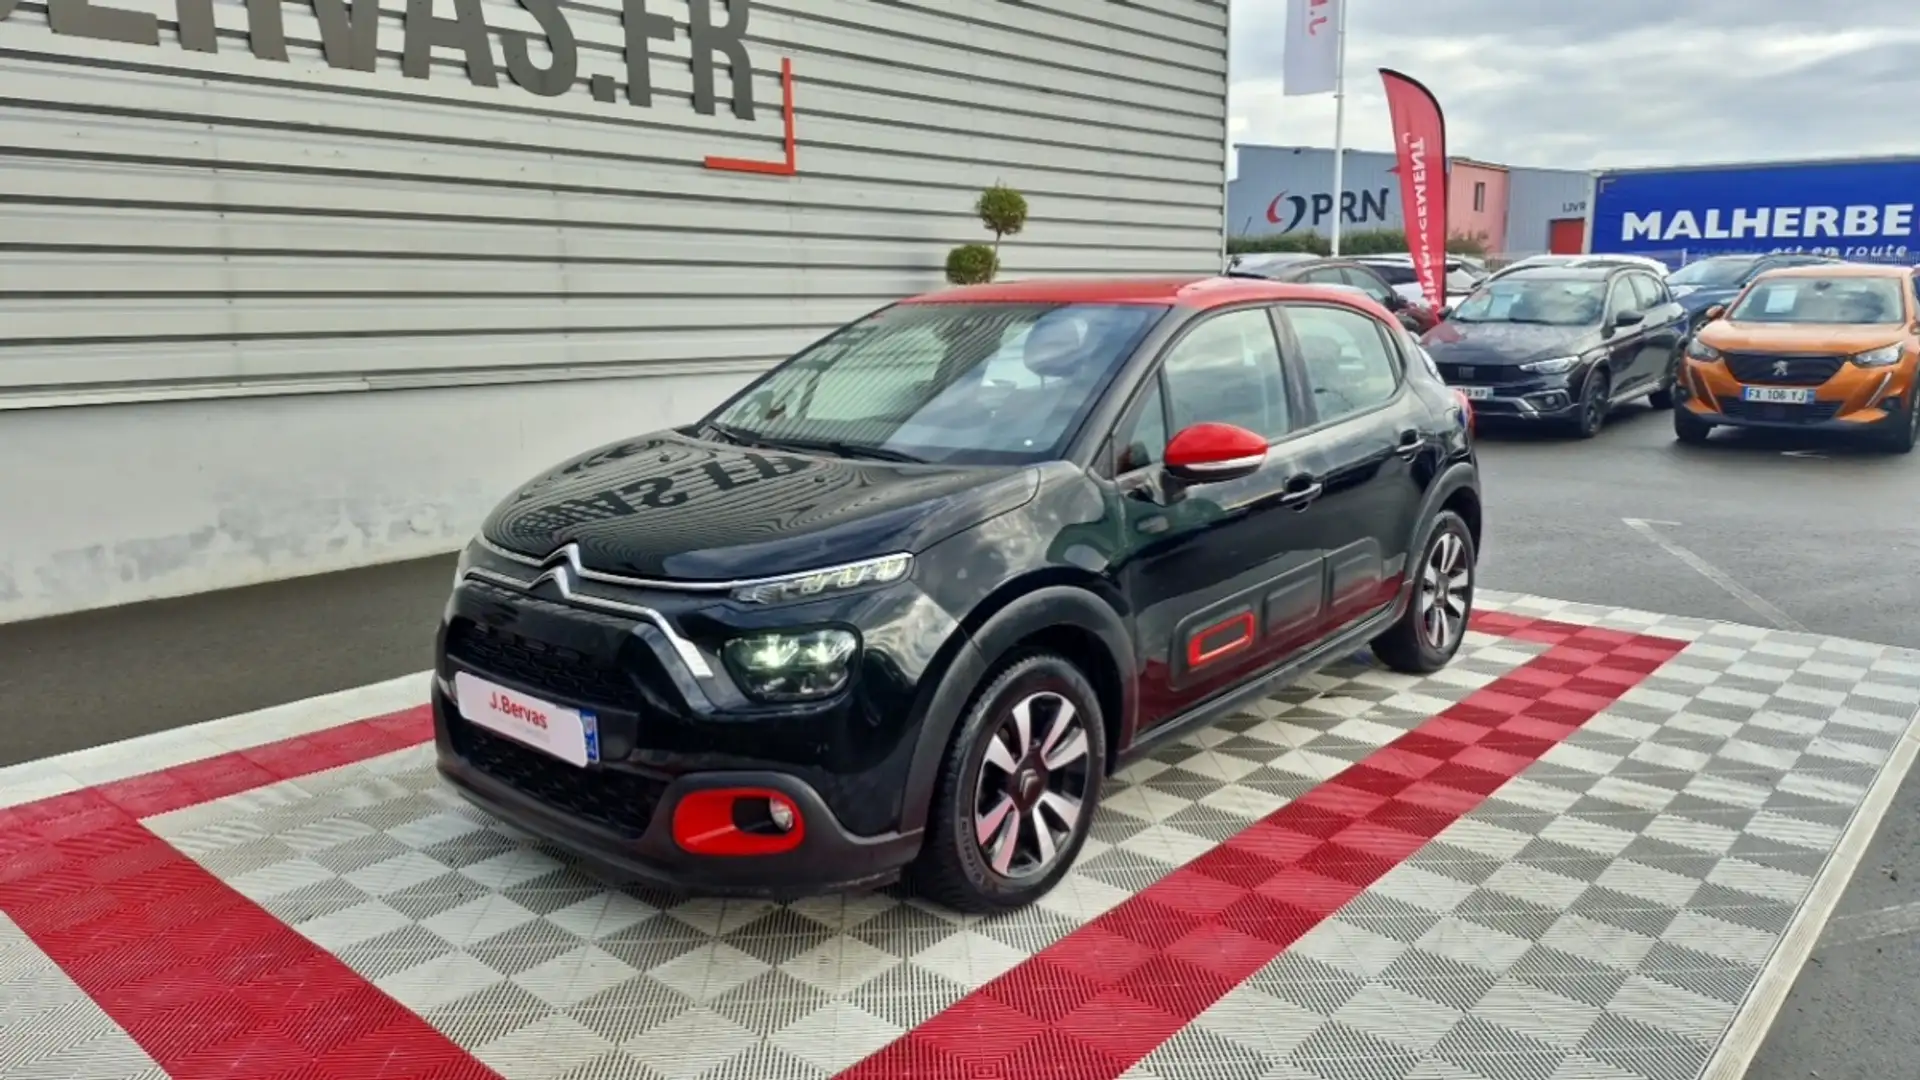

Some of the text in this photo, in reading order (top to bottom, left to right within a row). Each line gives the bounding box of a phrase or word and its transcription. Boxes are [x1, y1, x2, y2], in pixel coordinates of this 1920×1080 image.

[1311, 188, 1389, 226] PRN
[1621, 204, 1914, 241] MALHERBE
[1844, 244, 1908, 258] route
[489, 691, 549, 730] J.Bervas
